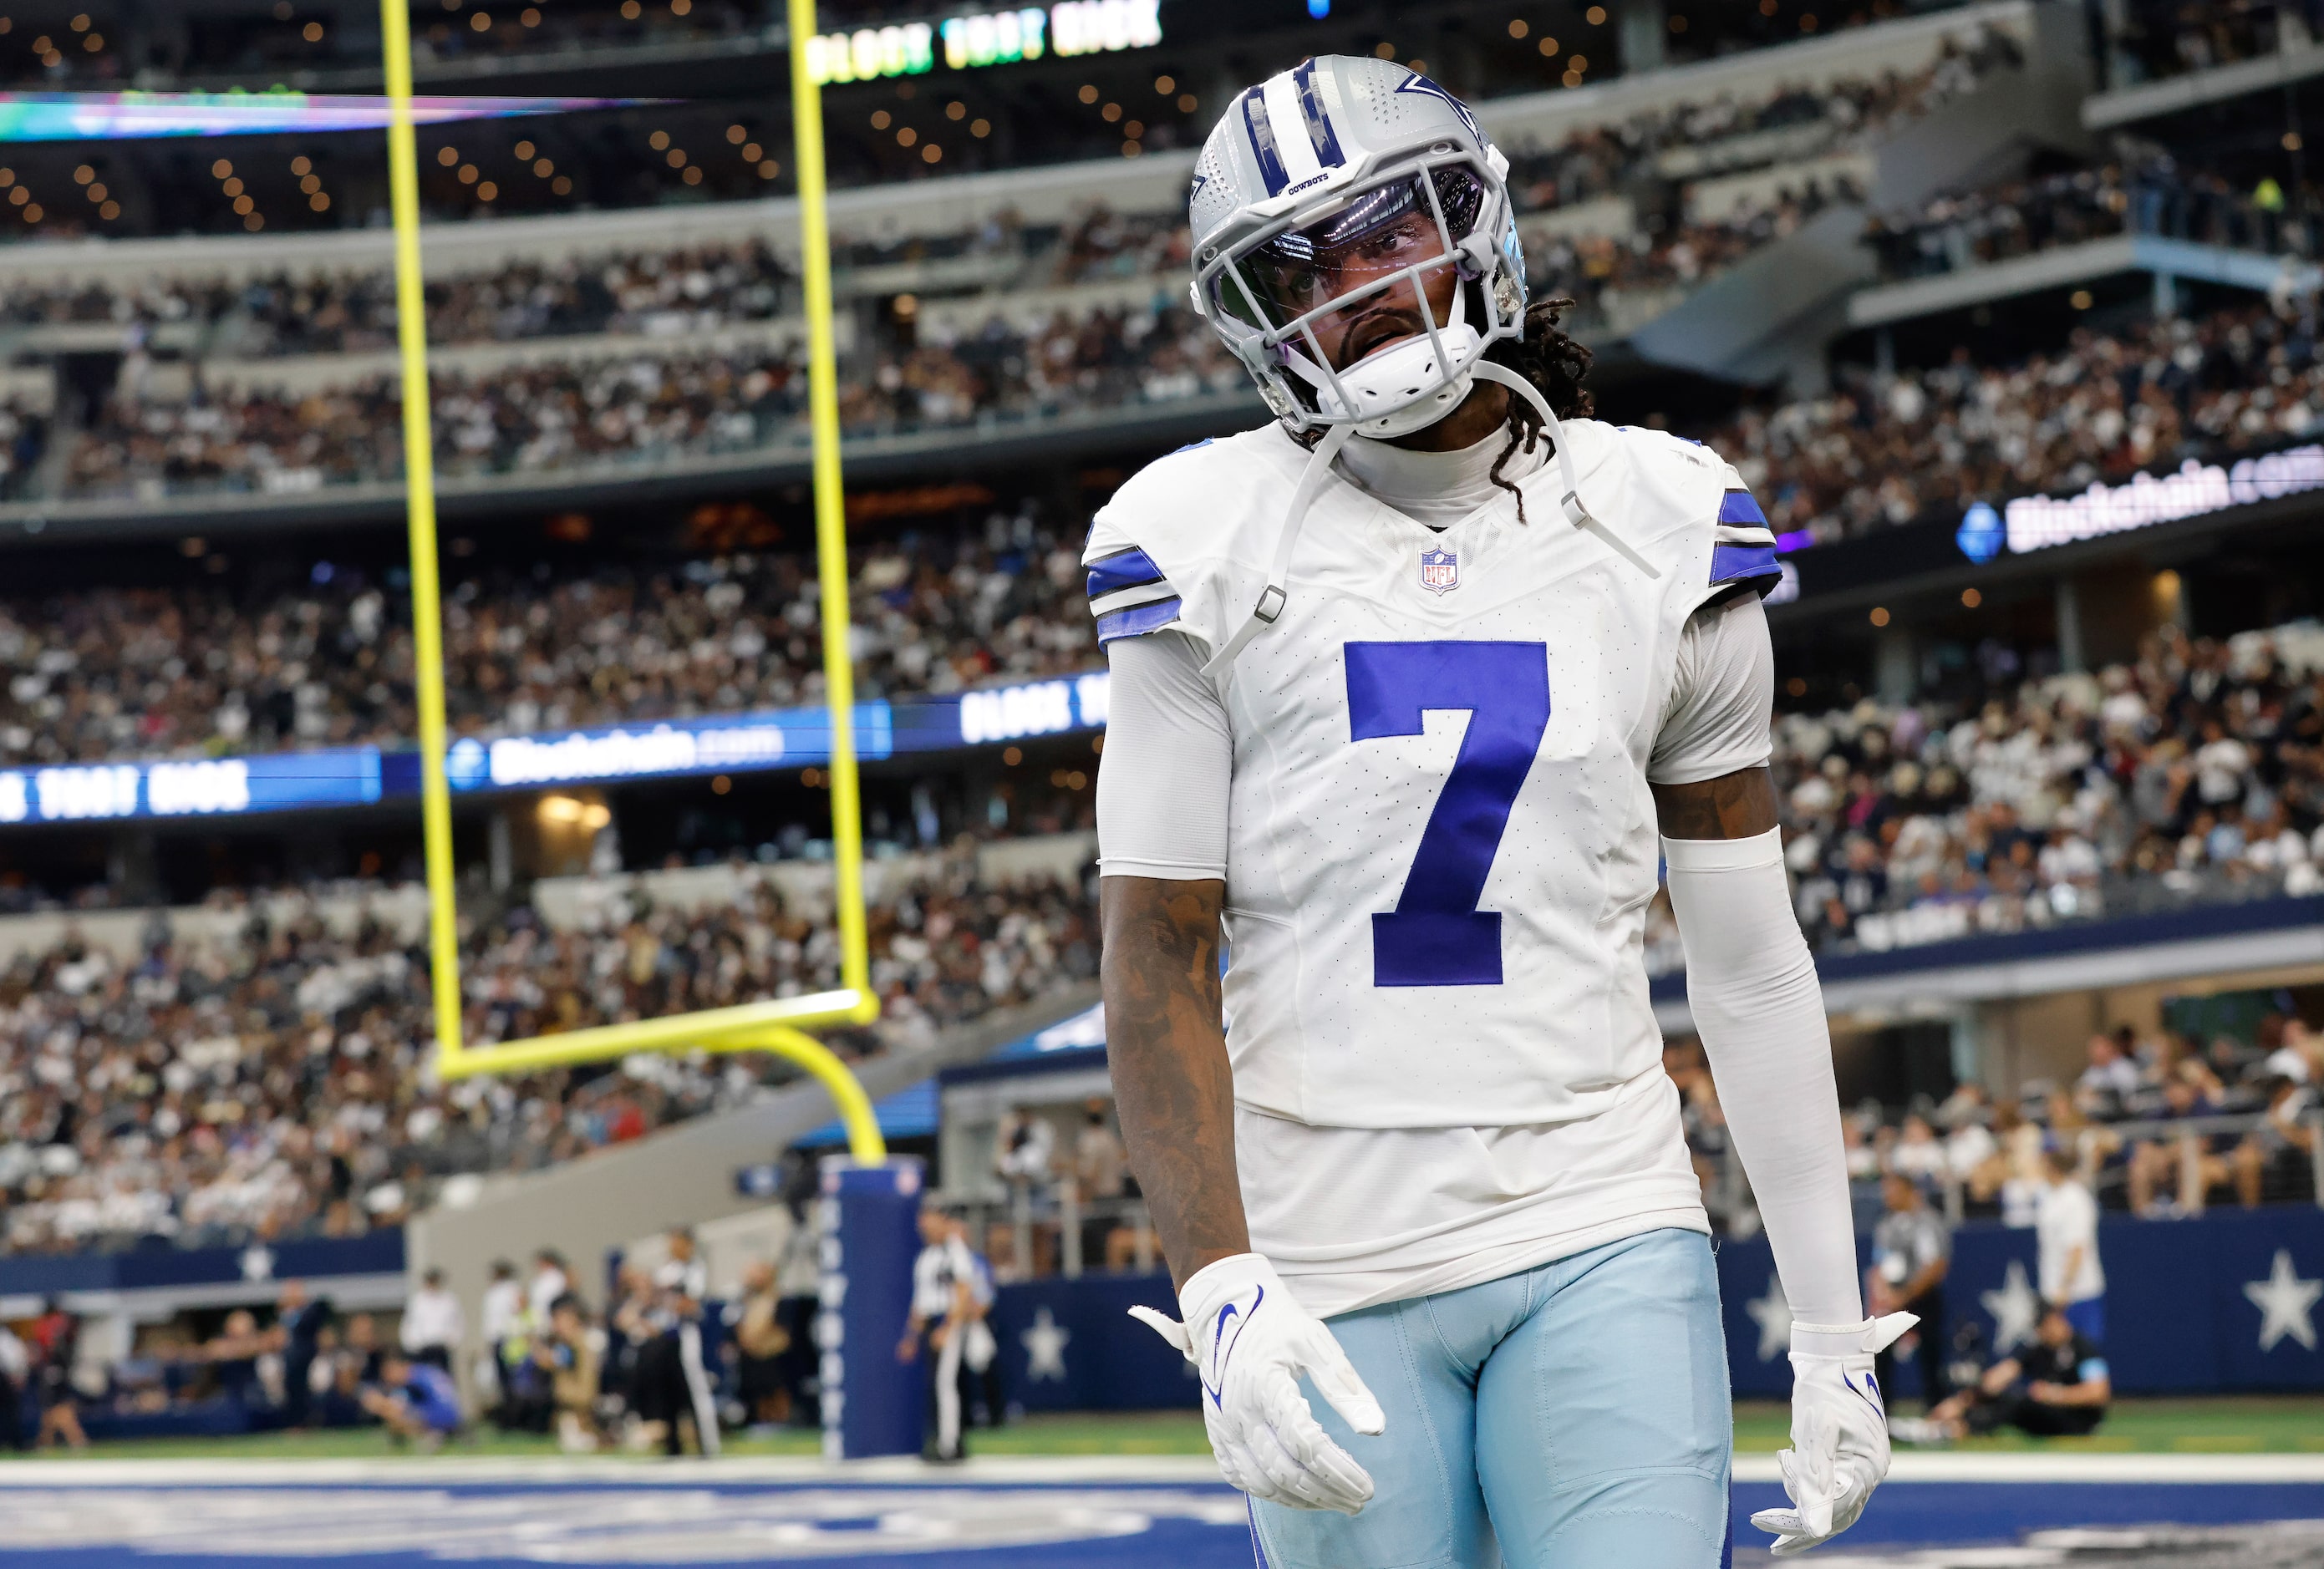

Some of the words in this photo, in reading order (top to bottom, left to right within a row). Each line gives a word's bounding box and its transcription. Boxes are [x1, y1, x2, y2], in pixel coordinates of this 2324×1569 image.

[1288, 172, 1329, 195] COWBOYS
[1425, 566, 1455, 586] NFL
[1343, 640, 1551, 987] 7
